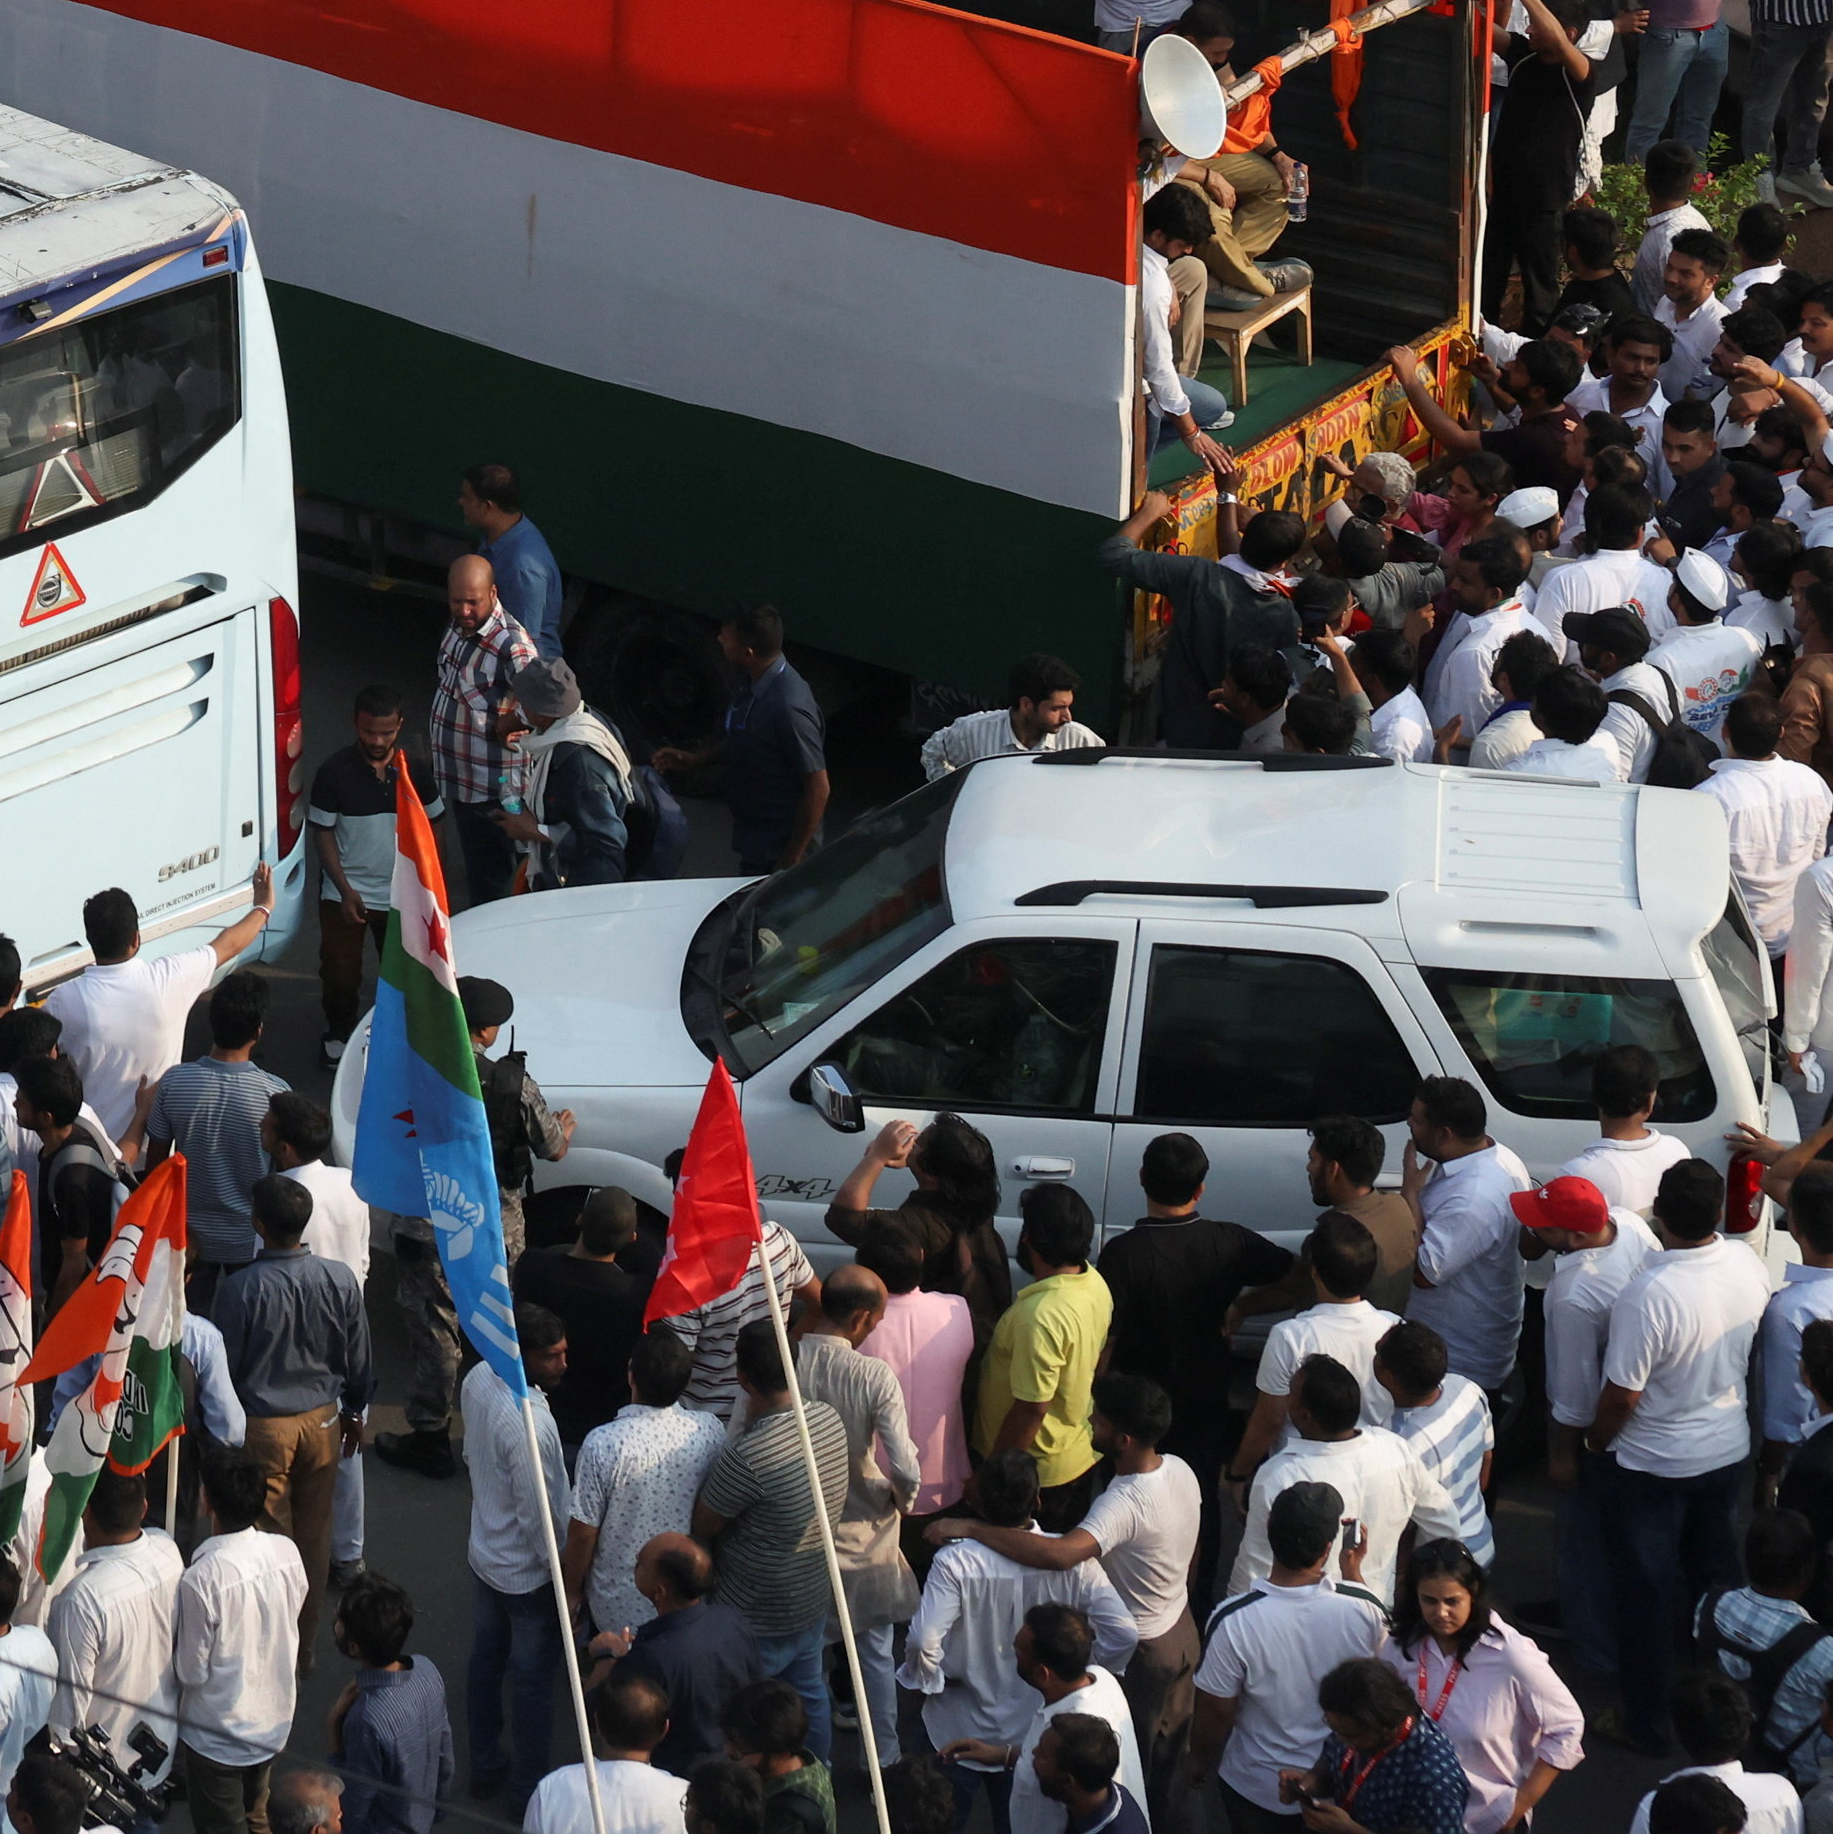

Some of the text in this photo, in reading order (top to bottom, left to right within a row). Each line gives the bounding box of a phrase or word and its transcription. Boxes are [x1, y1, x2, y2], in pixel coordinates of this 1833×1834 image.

[1249, 403, 1361, 493] BLOW HORN
[157, 844, 220, 883] 9400
[194, 882, 216, 900] SYSTEM
